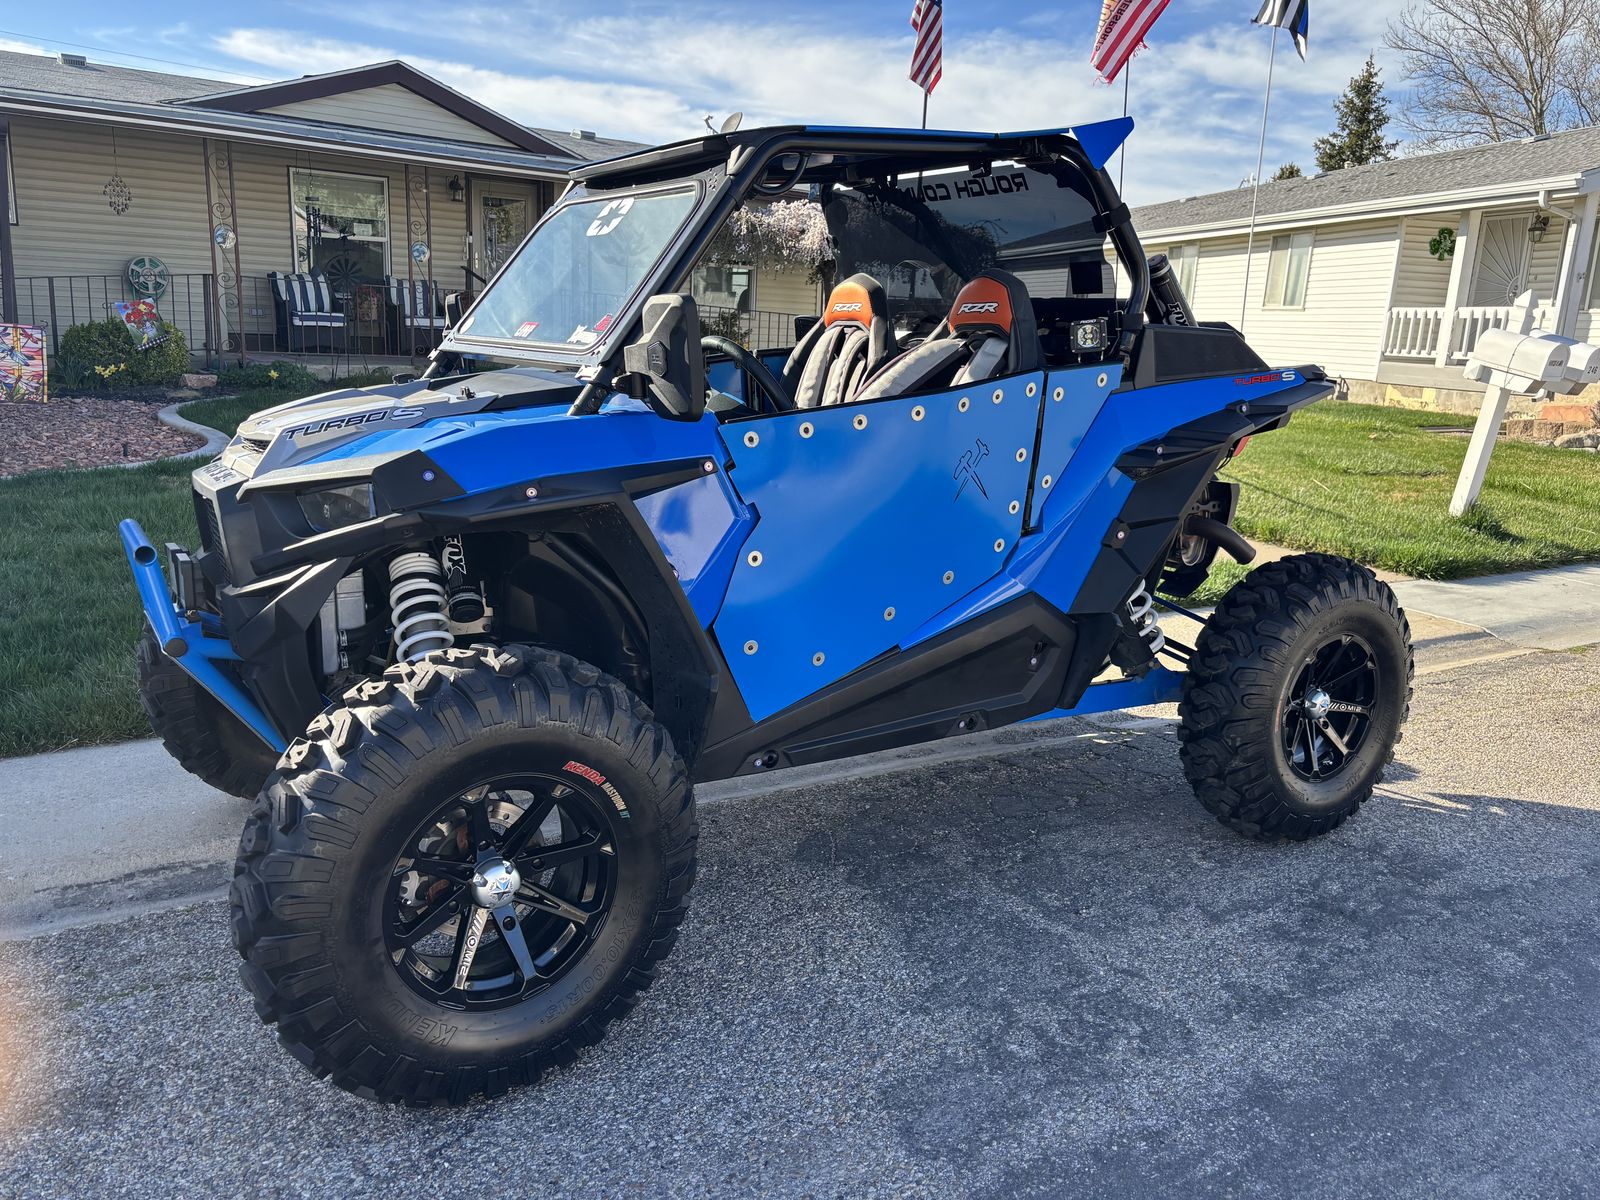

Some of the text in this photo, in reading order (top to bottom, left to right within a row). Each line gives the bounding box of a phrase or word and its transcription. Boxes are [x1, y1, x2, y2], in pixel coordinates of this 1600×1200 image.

[832, 302, 862, 313] RZR
[957, 302, 998, 314] RZR
[1235, 371, 1296, 385] TURBO S
[283, 406, 426, 440] TURBO S
[562, 760, 606, 785] KENDA
